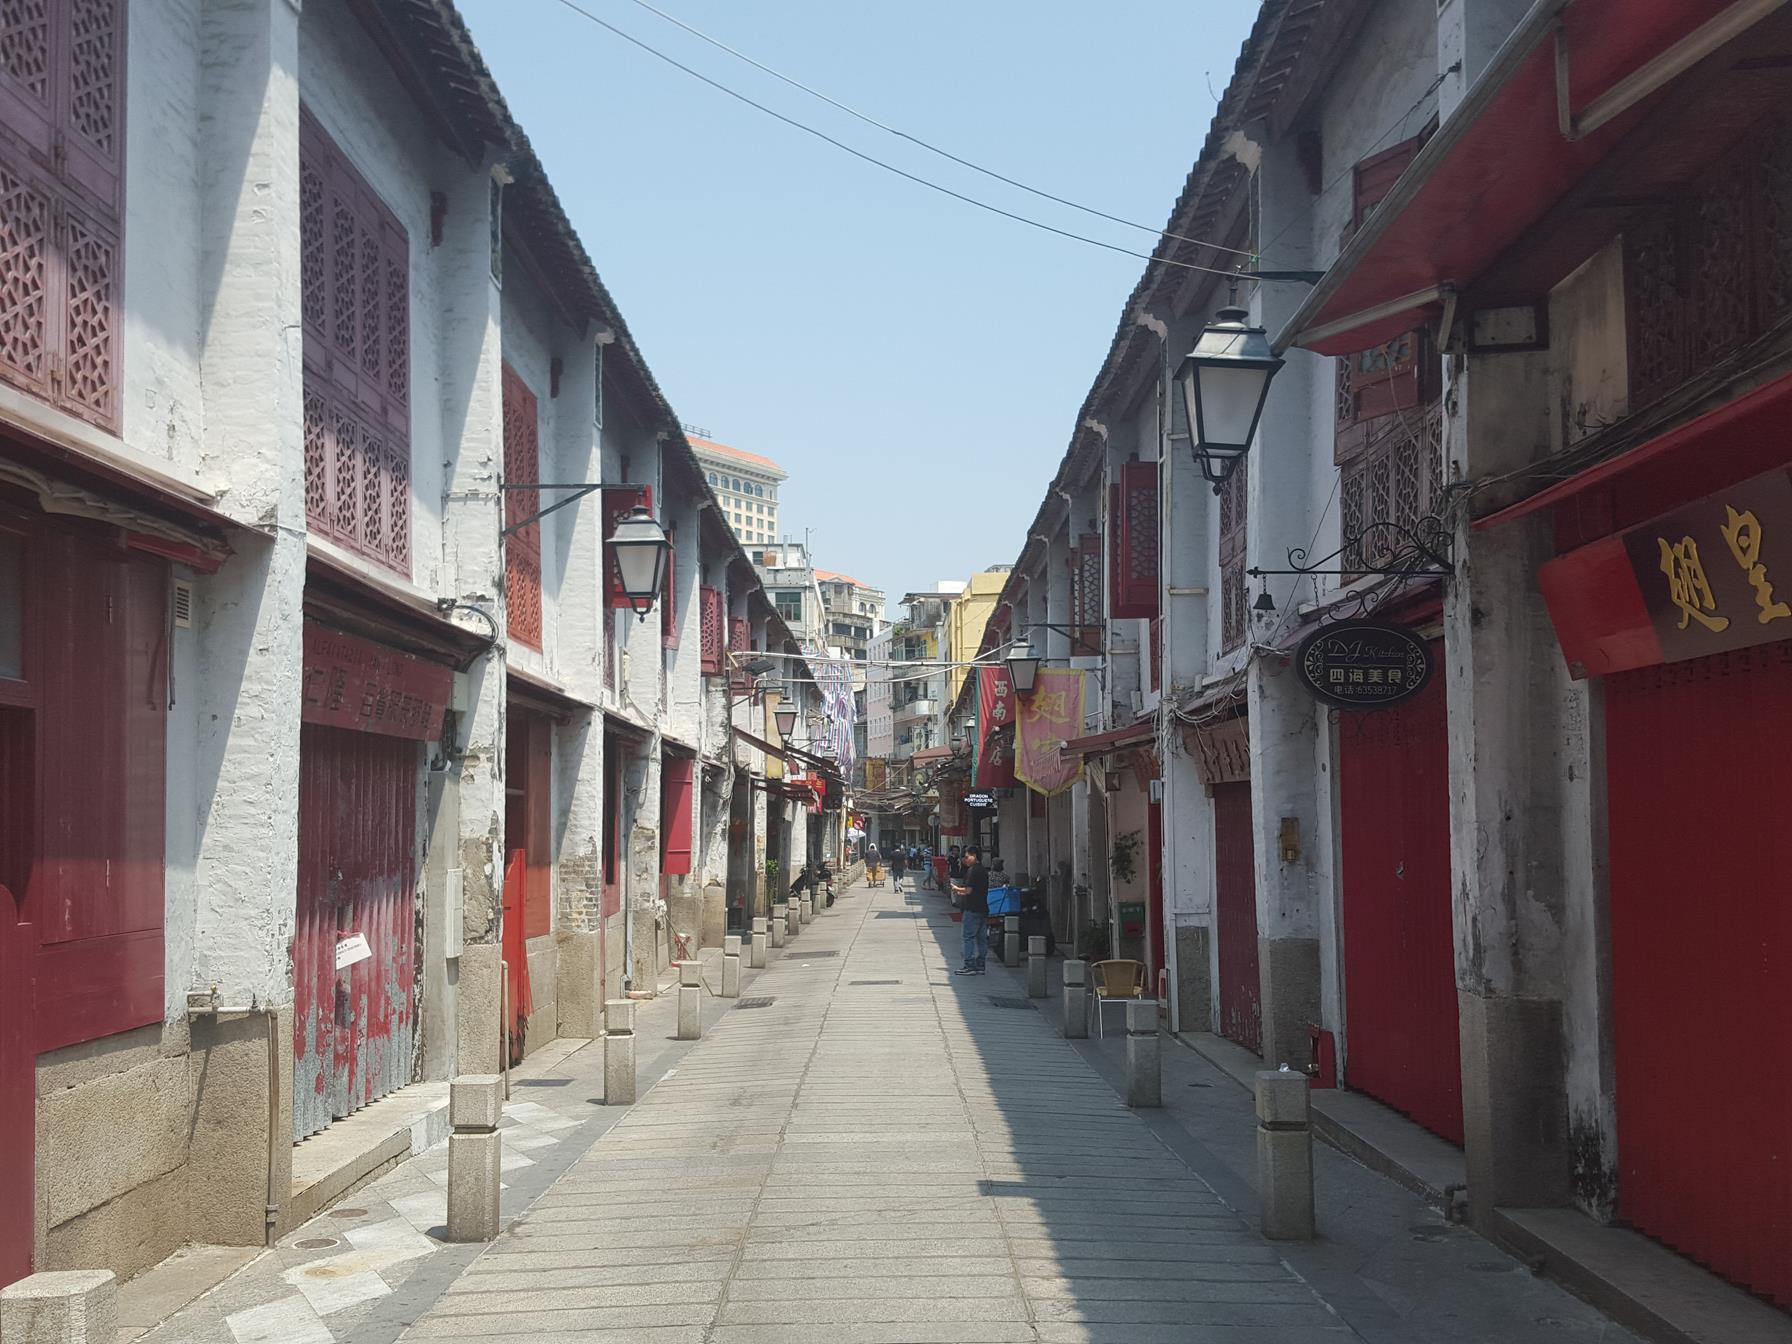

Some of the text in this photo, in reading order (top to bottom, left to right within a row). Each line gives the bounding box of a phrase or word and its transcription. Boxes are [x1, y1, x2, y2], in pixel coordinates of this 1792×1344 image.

[1329, 668, 1402, 684] 四海美食
[989, 680, 1008, 767] 西南店
